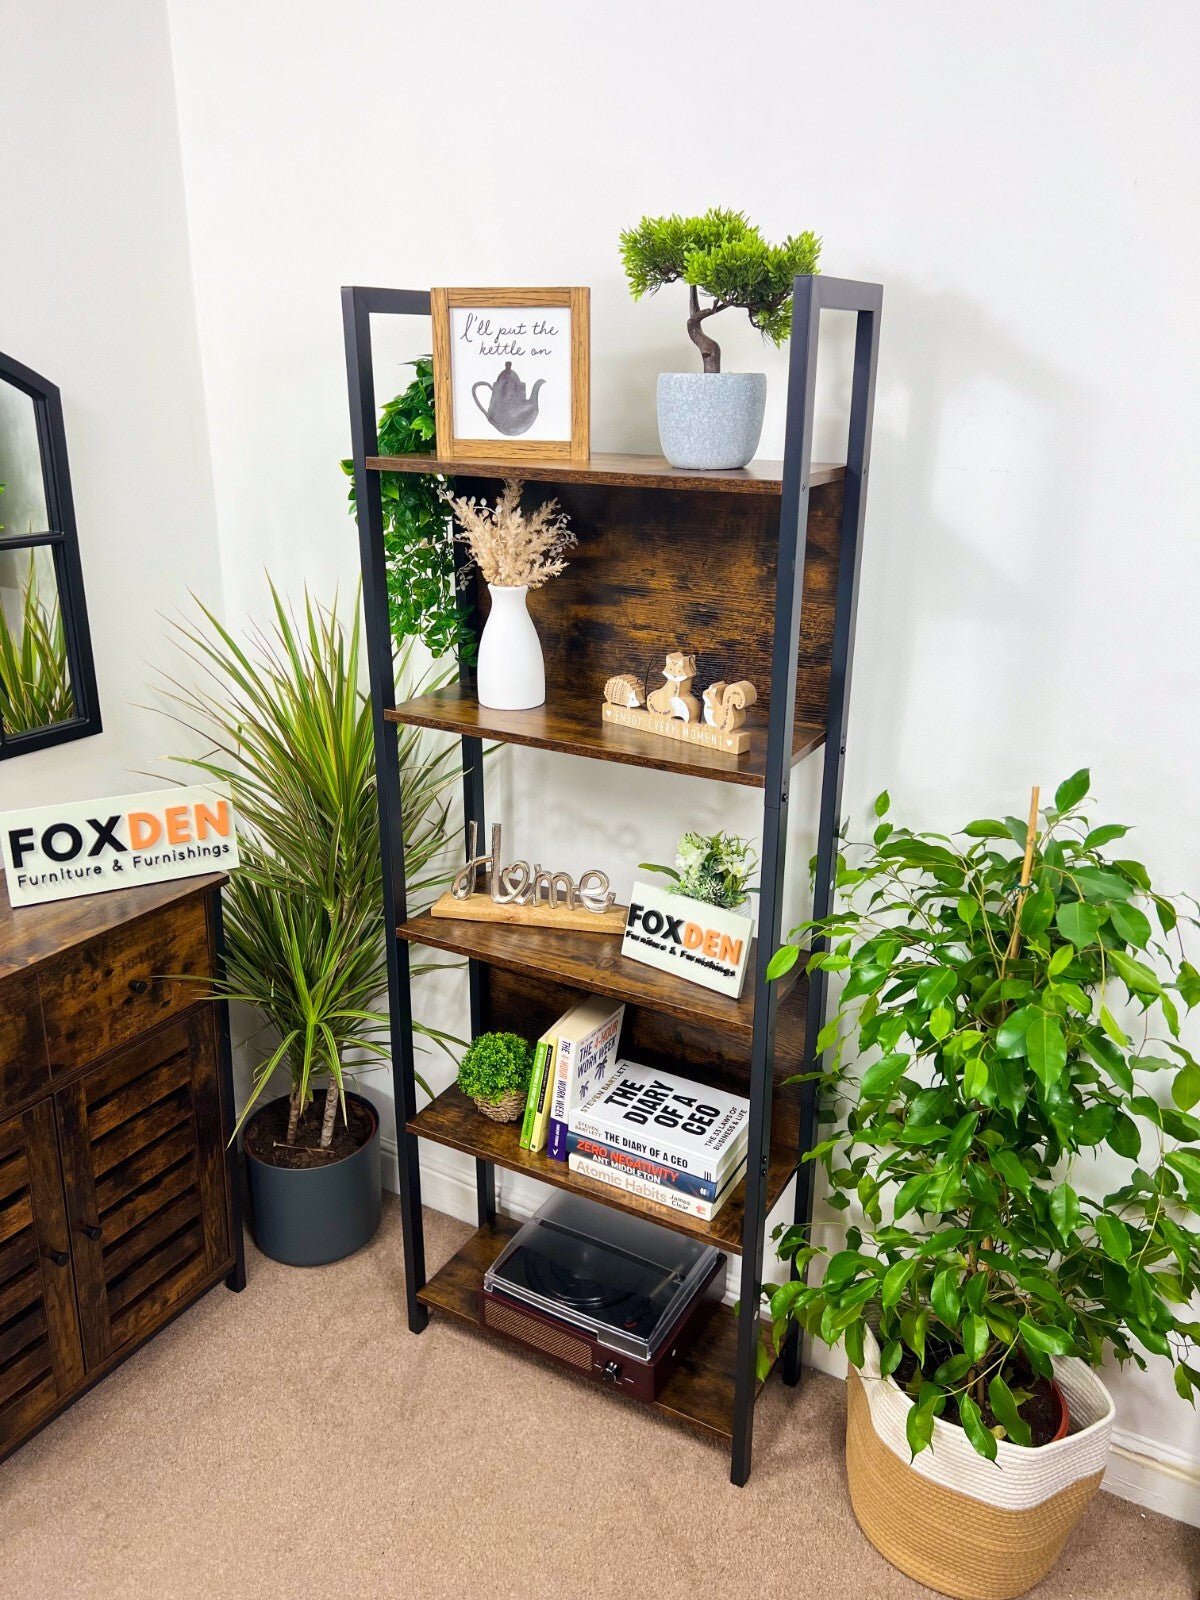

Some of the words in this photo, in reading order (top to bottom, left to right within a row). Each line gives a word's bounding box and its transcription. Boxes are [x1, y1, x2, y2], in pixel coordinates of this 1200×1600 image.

[460, 312, 493, 343] I'll
[494, 323, 527, 344] put
[533, 320, 559, 336] the
[479, 340, 526, 356] kettle
[531, 347, 553, 356] on
[615, 711, 642, 726] ENJOY
[649, 718, 676, 735] EVERY
[682, 727, 723, 747] MOMENT
[8, 800, 230, 869] FOXDEN
[18, 864, 102, 888] Furniture
[112, 859, 124, 872] &
[133, 843, 230, 869] Furnishings
[627, 903, 743, 966] FOXDEN
[625, 930, 667, 951] Furniture
[669, 946, 677, 956] &
[680, 950, 736, 977] Furnishings
[562, 1040, 571, 1055] THE
[578, 1051, 598, 1079] WORK
[598, 1034, 617, 1060] WEEK
[580, 1041, 593, 1063] THE
[556, 1080, 567, 1099] WORK
[580, 1090, 605, 1114] STEVEN
[602, 1063, 630, 1090] BARTLETT
[603, 1079, 646, 1107] THE
[623, 1080, 675, 1125] DIARY
[554, 1099, 565, 1118] WEEK
[654, 1105, 684, 1128] OF
[672, 1094, 698, 1108] A
[681, 1104, 721, 1136] CEO
[574, 1125, 602, 1138] BARTLETT
[577, 1121, 599, 1133] STEVEN
[704, 1135, 717, 1147] THE
[713, 1128, 722, 1138] 33
[718, 1114, 733, 1130] LAWS
[729, 1106, 738, 1115] OF
[713, 1125, 736, 1151] BUSINESS
[735, 1109, 748, 1122] LIFE
[576, 1138, 608, 1157] ZERO
[610, 1150, 680, 1183] NEGATIVITY
[604, 1130, 621, 1145] THE
[622, 1137, 647, 1154] DIARY
[649, 1147, 661, 1158] OF
[662, 1152, 669, 1162] A
[670, 1155, 688, 1169] CEO
[576, 1160, 622, 1185] Atomic
[625, 1177, 667, 1203] Habits
[592, 1154, 610, 1166] ANT
[611, 1160, 661, 1185] MIDDLETON
[670, 1194, 691, 1207] James
[671, 1201, 689, 1211] Clear
